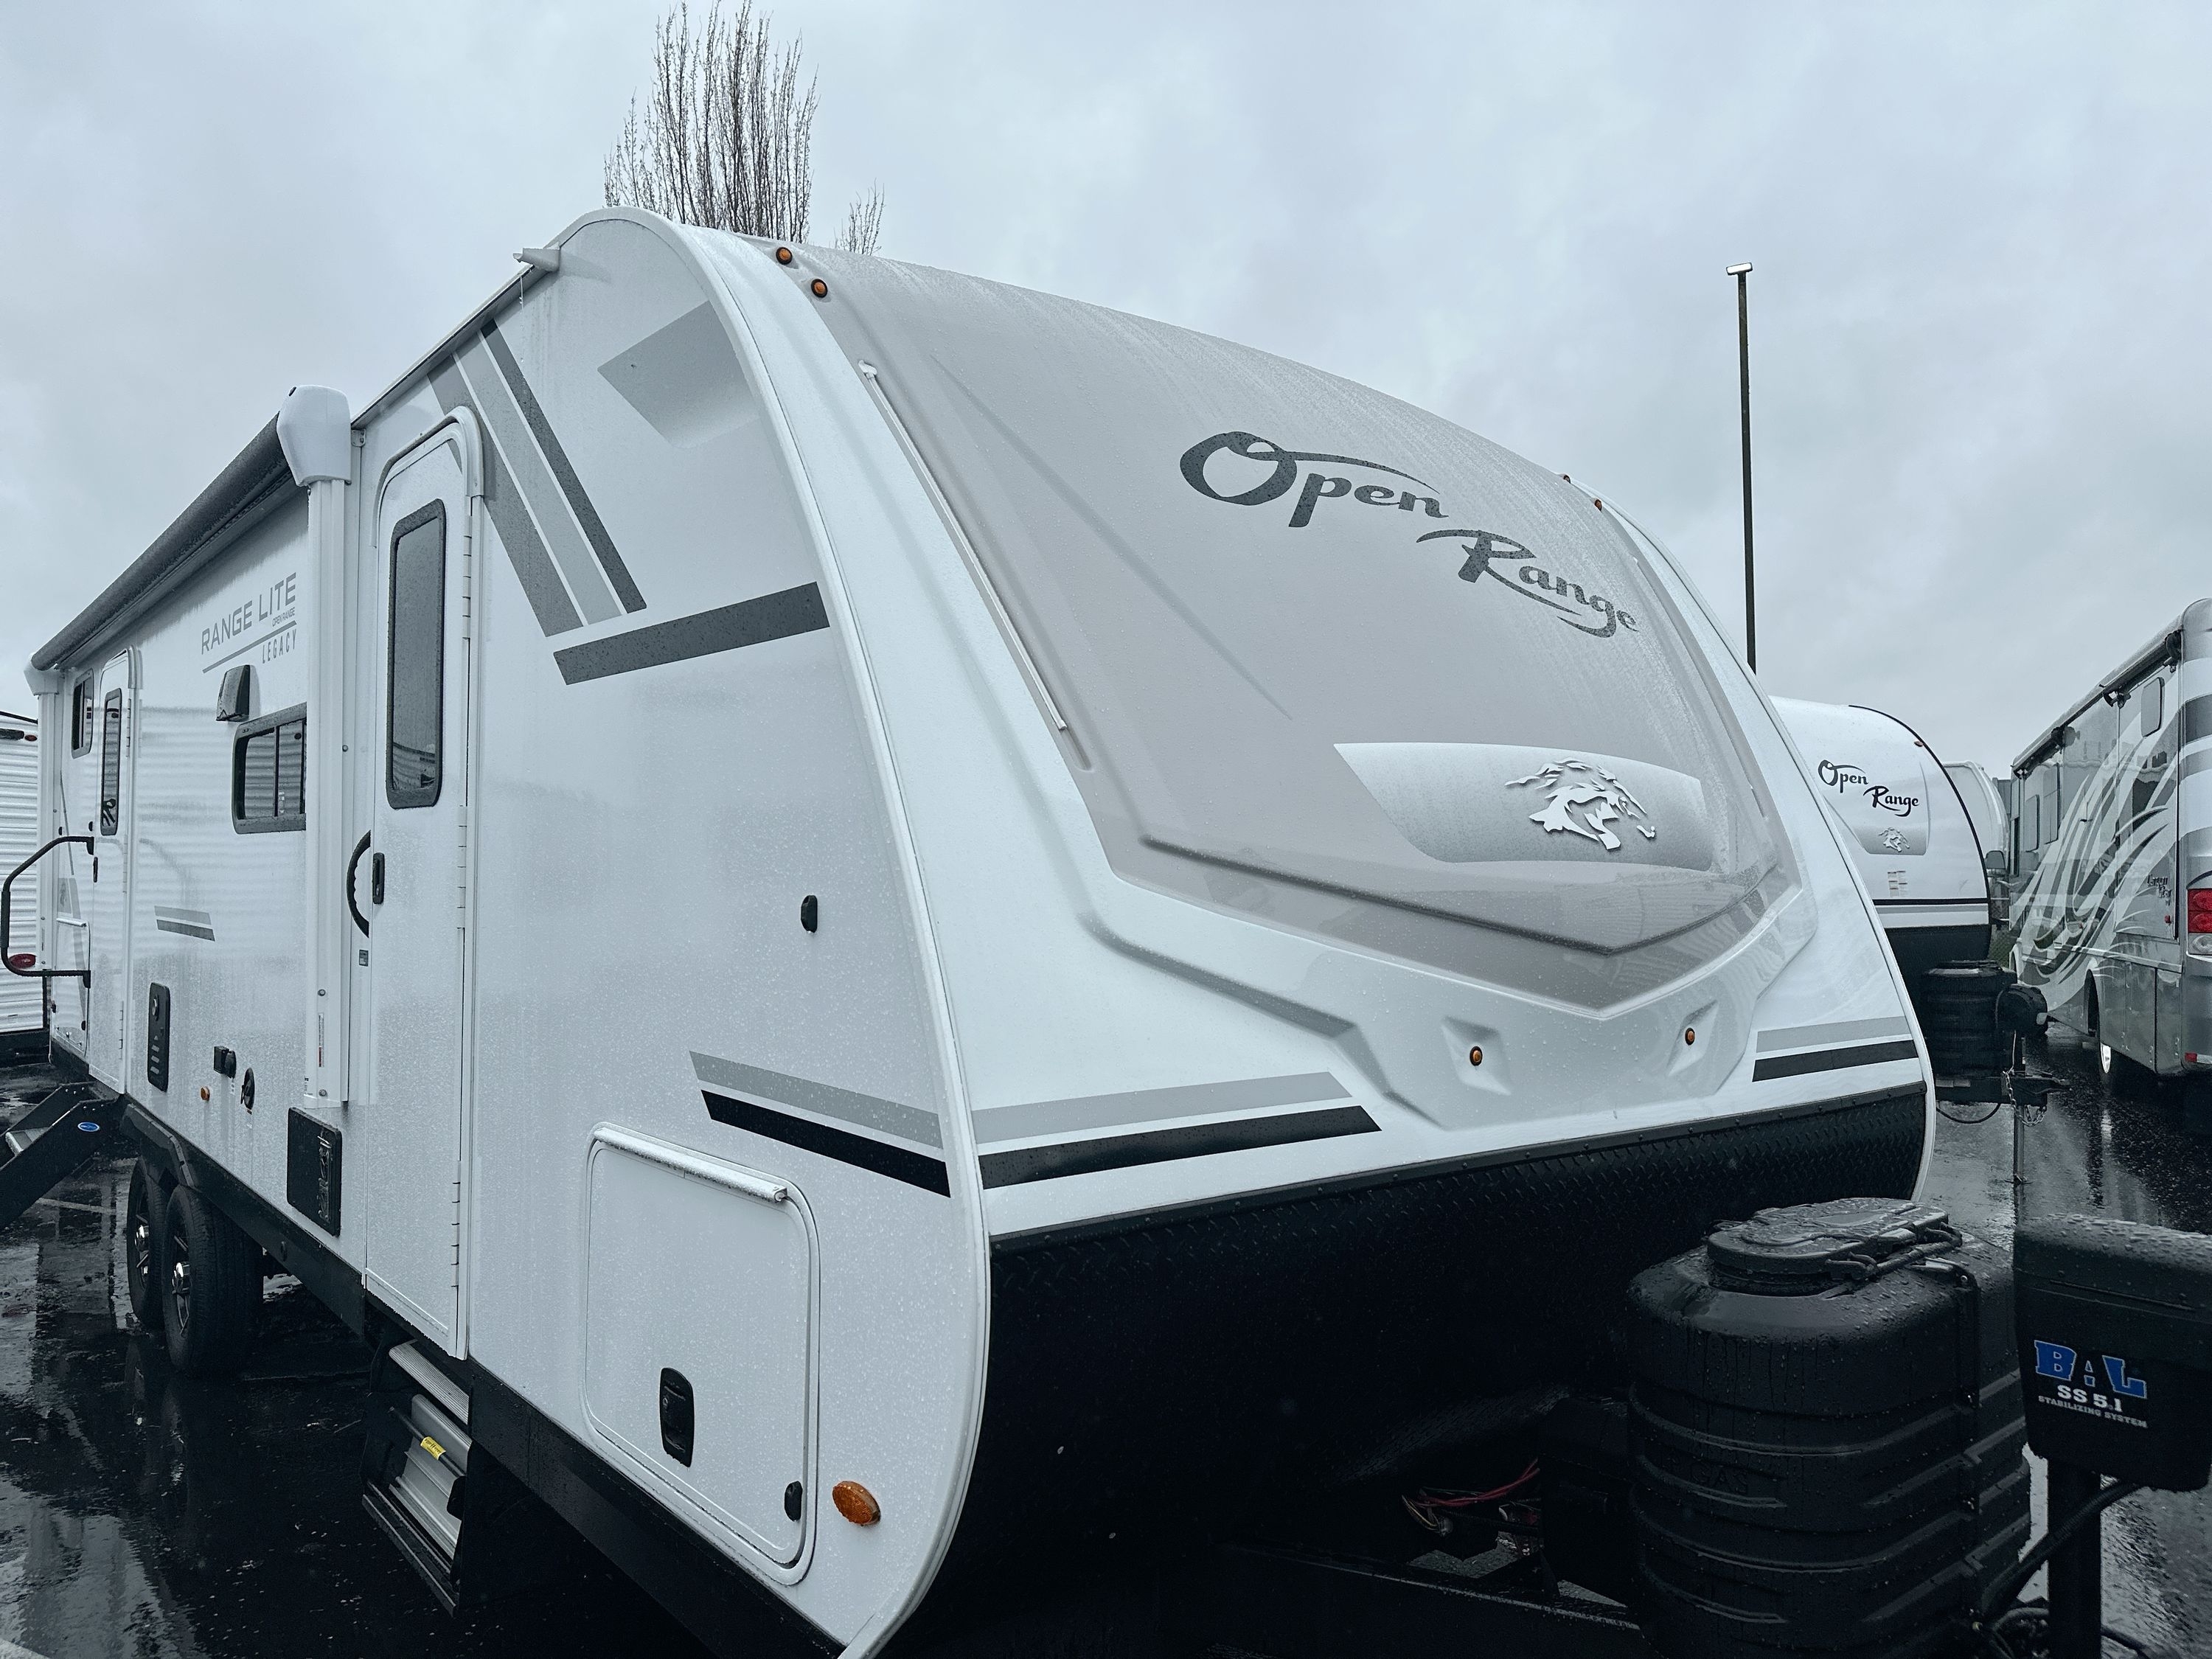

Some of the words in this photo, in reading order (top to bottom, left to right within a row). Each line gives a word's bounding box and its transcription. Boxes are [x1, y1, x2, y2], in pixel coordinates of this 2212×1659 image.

[1180, 430, 1450, 528] Open
[1416, 529, 1639, 639] Range
[201, 600, 252, 655] RANGE
[259, 571, 296, 621] LITE
[262, 628, 297, 664] LEGACY
[1818, 759, 1868, 793] Open
[1863, 785, 1919, 817] Range
[2034, 1340, 2147, 1399] BAL
[2038, 1395, 2102, 1417] STABILIZING
[2104, 1411, 2149, 1428] SYSTEM
[2057, 1385, 2088, 1403] SS
[1691, 1463, 1748, 1495] GAS
